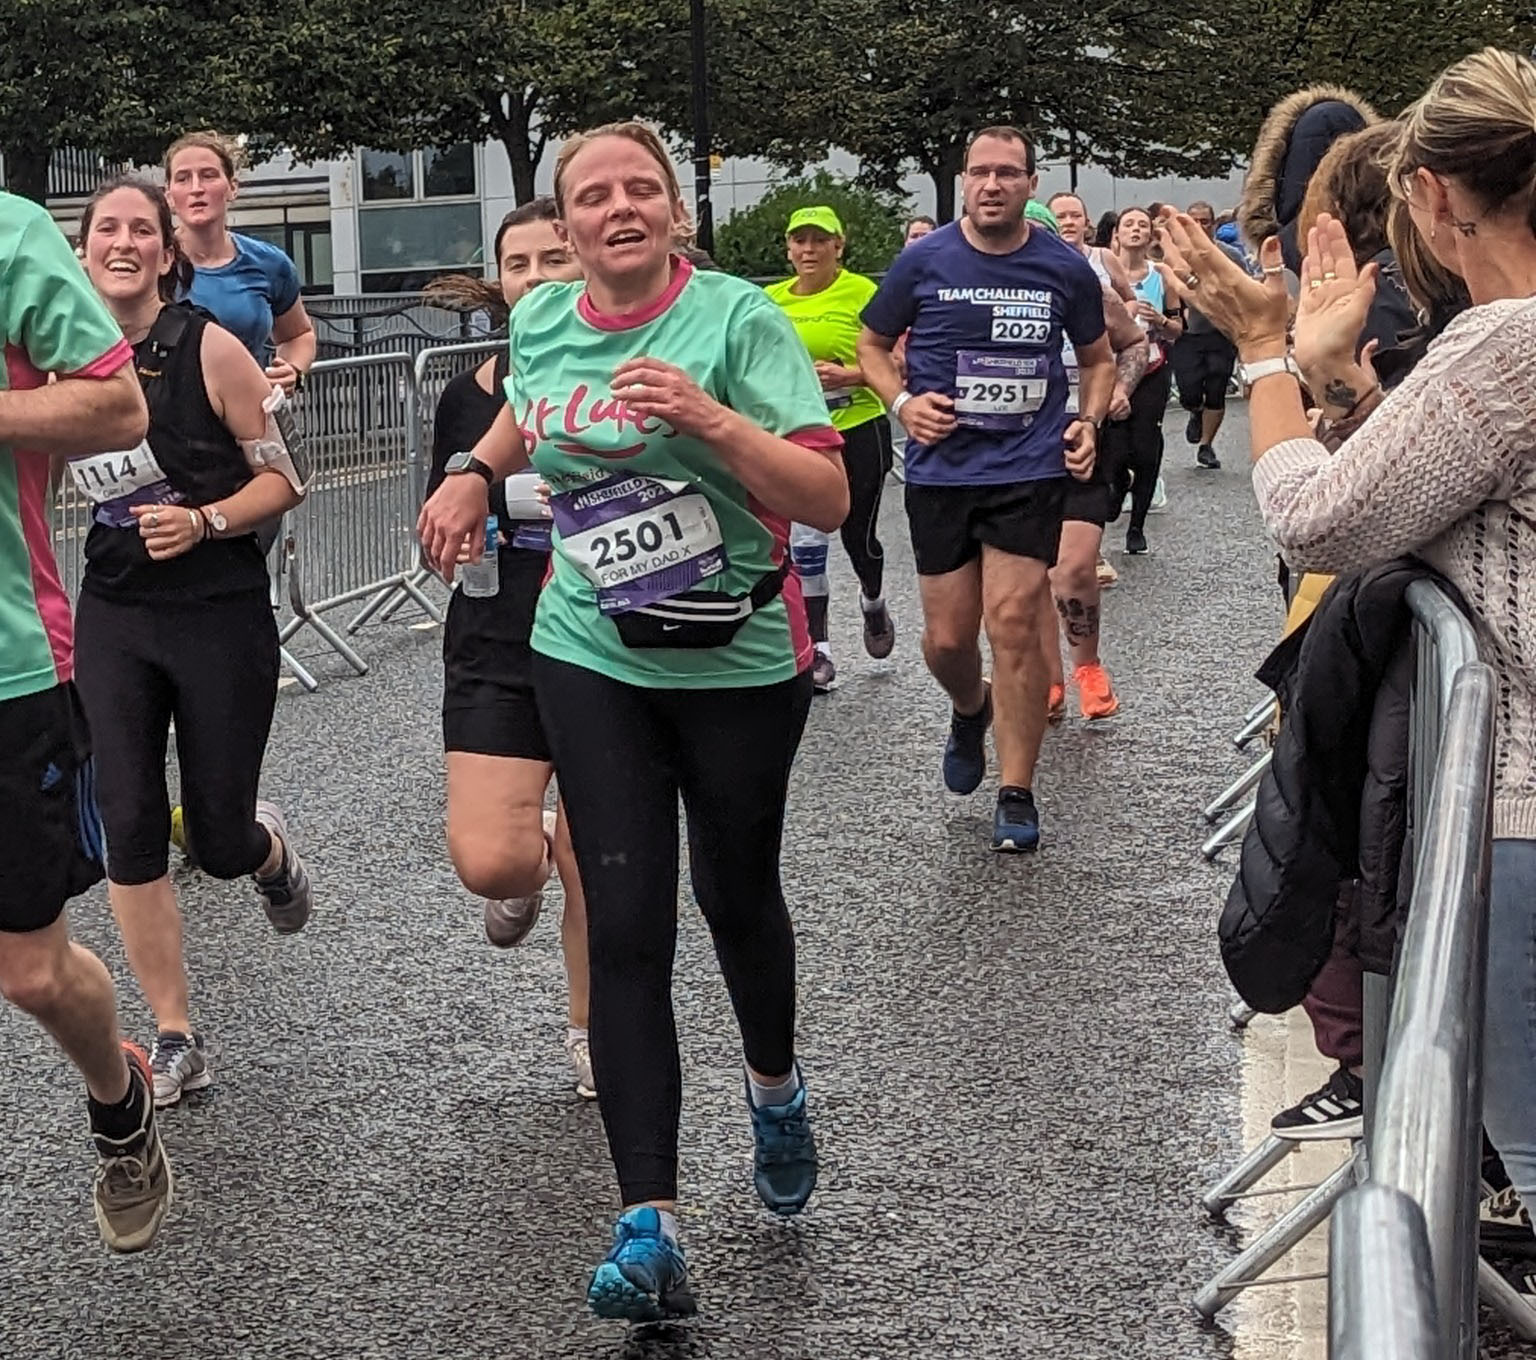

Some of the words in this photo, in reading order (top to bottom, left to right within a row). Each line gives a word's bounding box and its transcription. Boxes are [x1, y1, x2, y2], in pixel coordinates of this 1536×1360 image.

[992, 306, 1051, 319] SHEFFIELD
[994, 322, 1049, 341] 2023
[972, 383, 1029, 403] 2951
[77, 454, 138, 490] 1114
[637, 485, 667, 503] 202
[590, 511, 684, 570] 2501
[600, 568, 628, 586] FOR
[629, 559, 651, 577] MY
[651, 550, 680, 568] DAD
[681, 544, 693, 556] X
